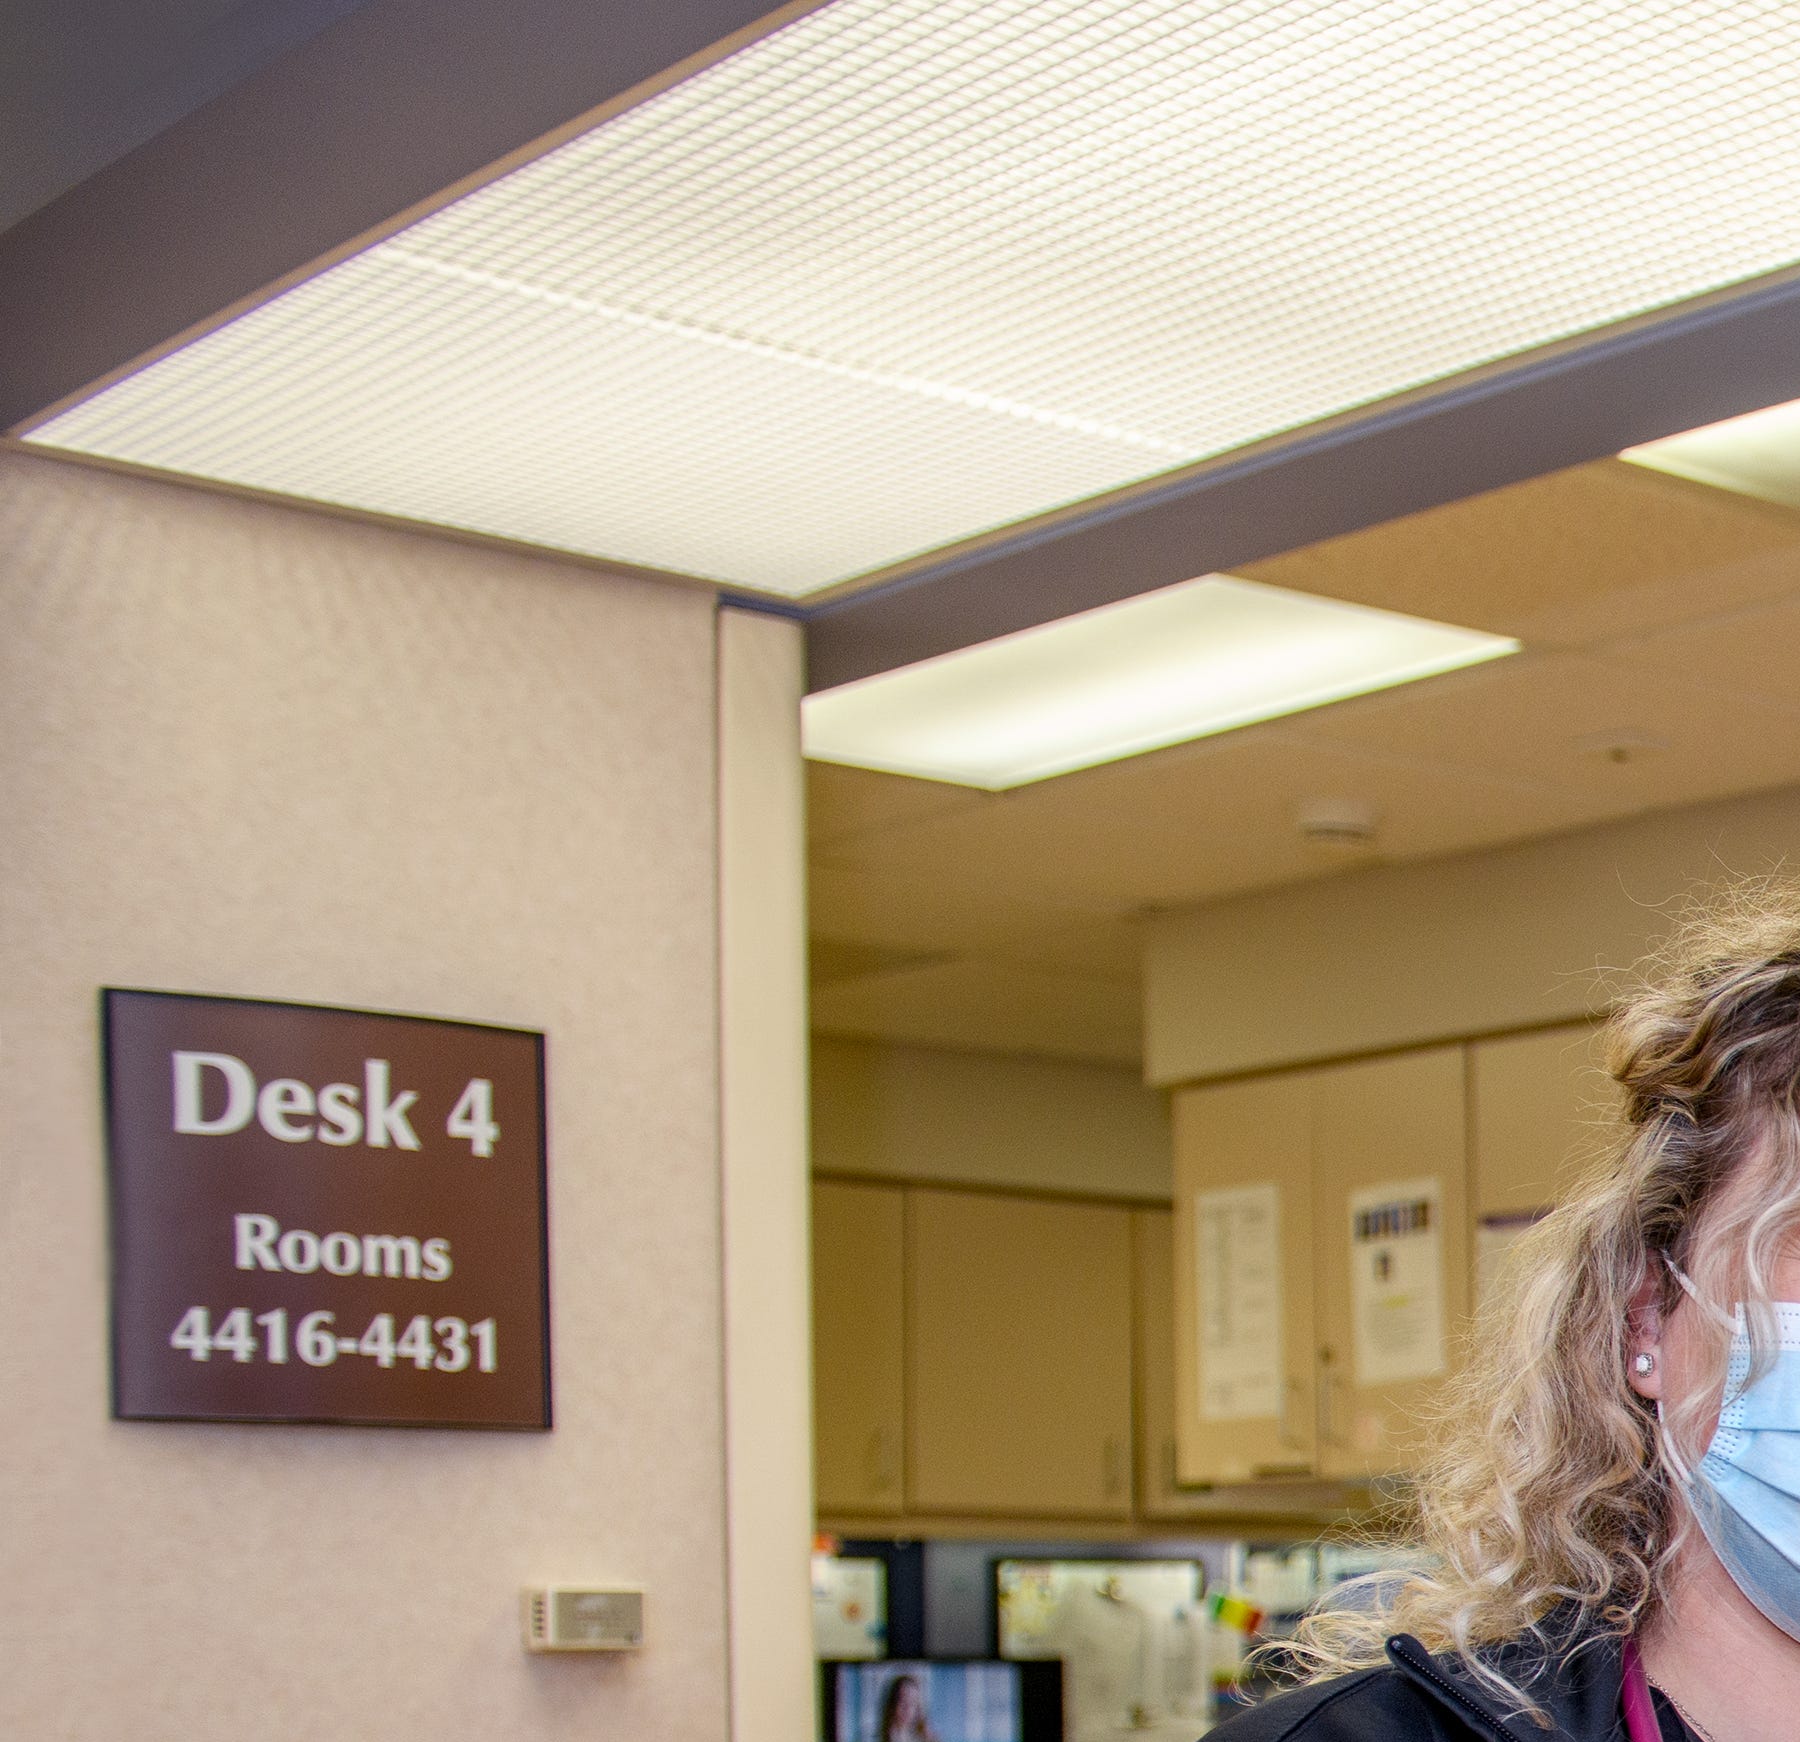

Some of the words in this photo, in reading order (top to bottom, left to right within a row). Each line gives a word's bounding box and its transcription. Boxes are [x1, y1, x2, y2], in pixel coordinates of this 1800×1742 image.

[170, 1049, 423, 1152] Desk
[446, 1078, 501, 1159] 4
[233, 1213, 454, 1282] Rooms
[170, 1305, 498, 1374] 4416-4431
